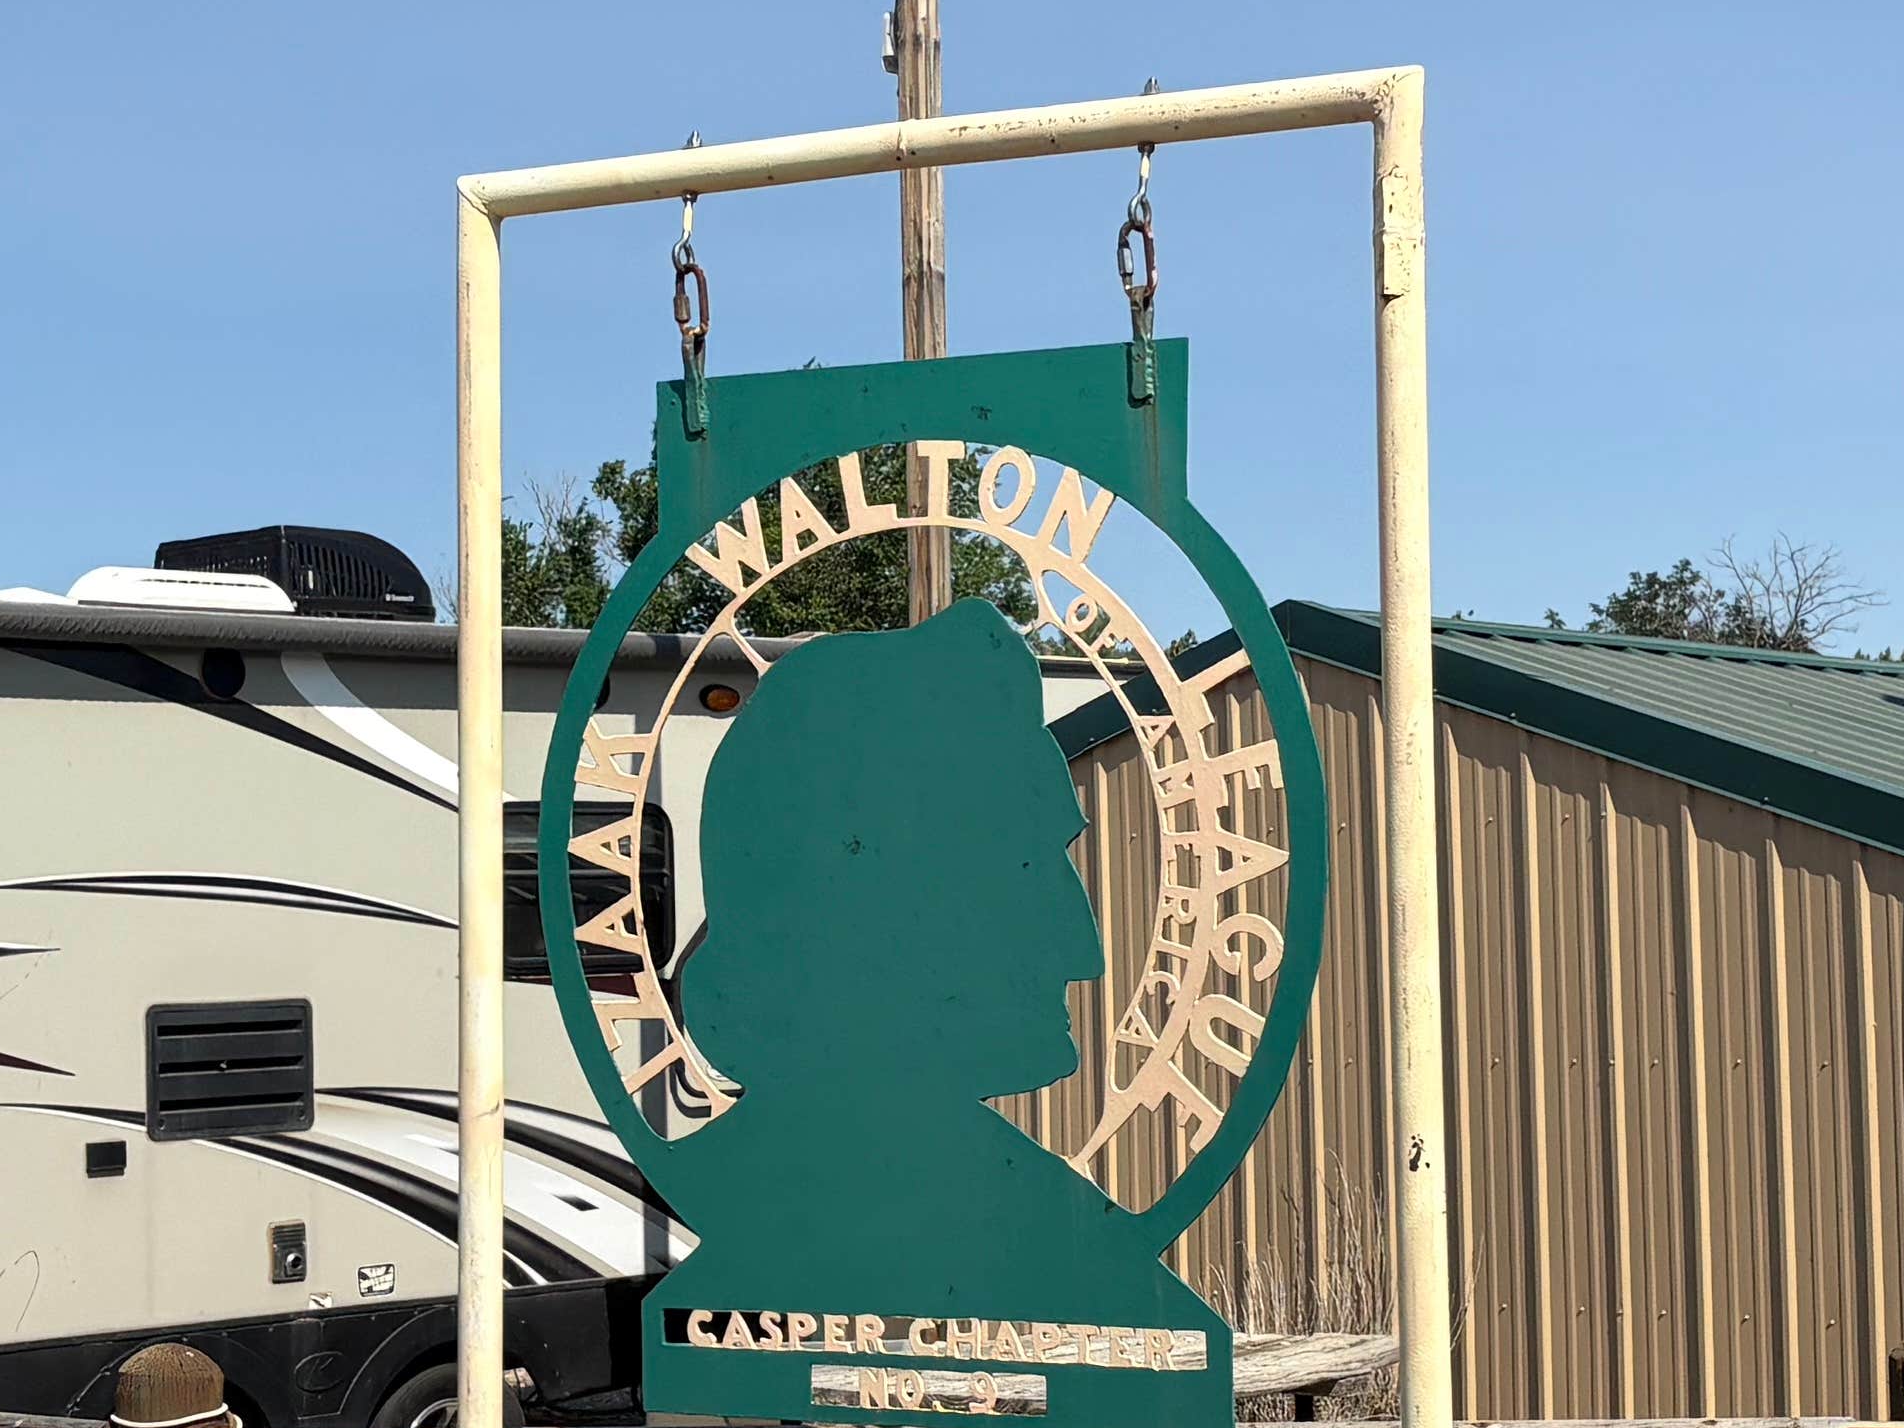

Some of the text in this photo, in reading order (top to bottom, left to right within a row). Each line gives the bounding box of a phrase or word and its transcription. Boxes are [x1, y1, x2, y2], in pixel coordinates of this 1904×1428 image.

[568, 440, 1290, 1154] IZAAK WALTON LEAGUE
[1065, 592, 1199, 1050] OF AMERICA
[687, 1309, 1175, 1371] CASPER CHAPTER
[858, 1368, 999, 1414] NO. 9
